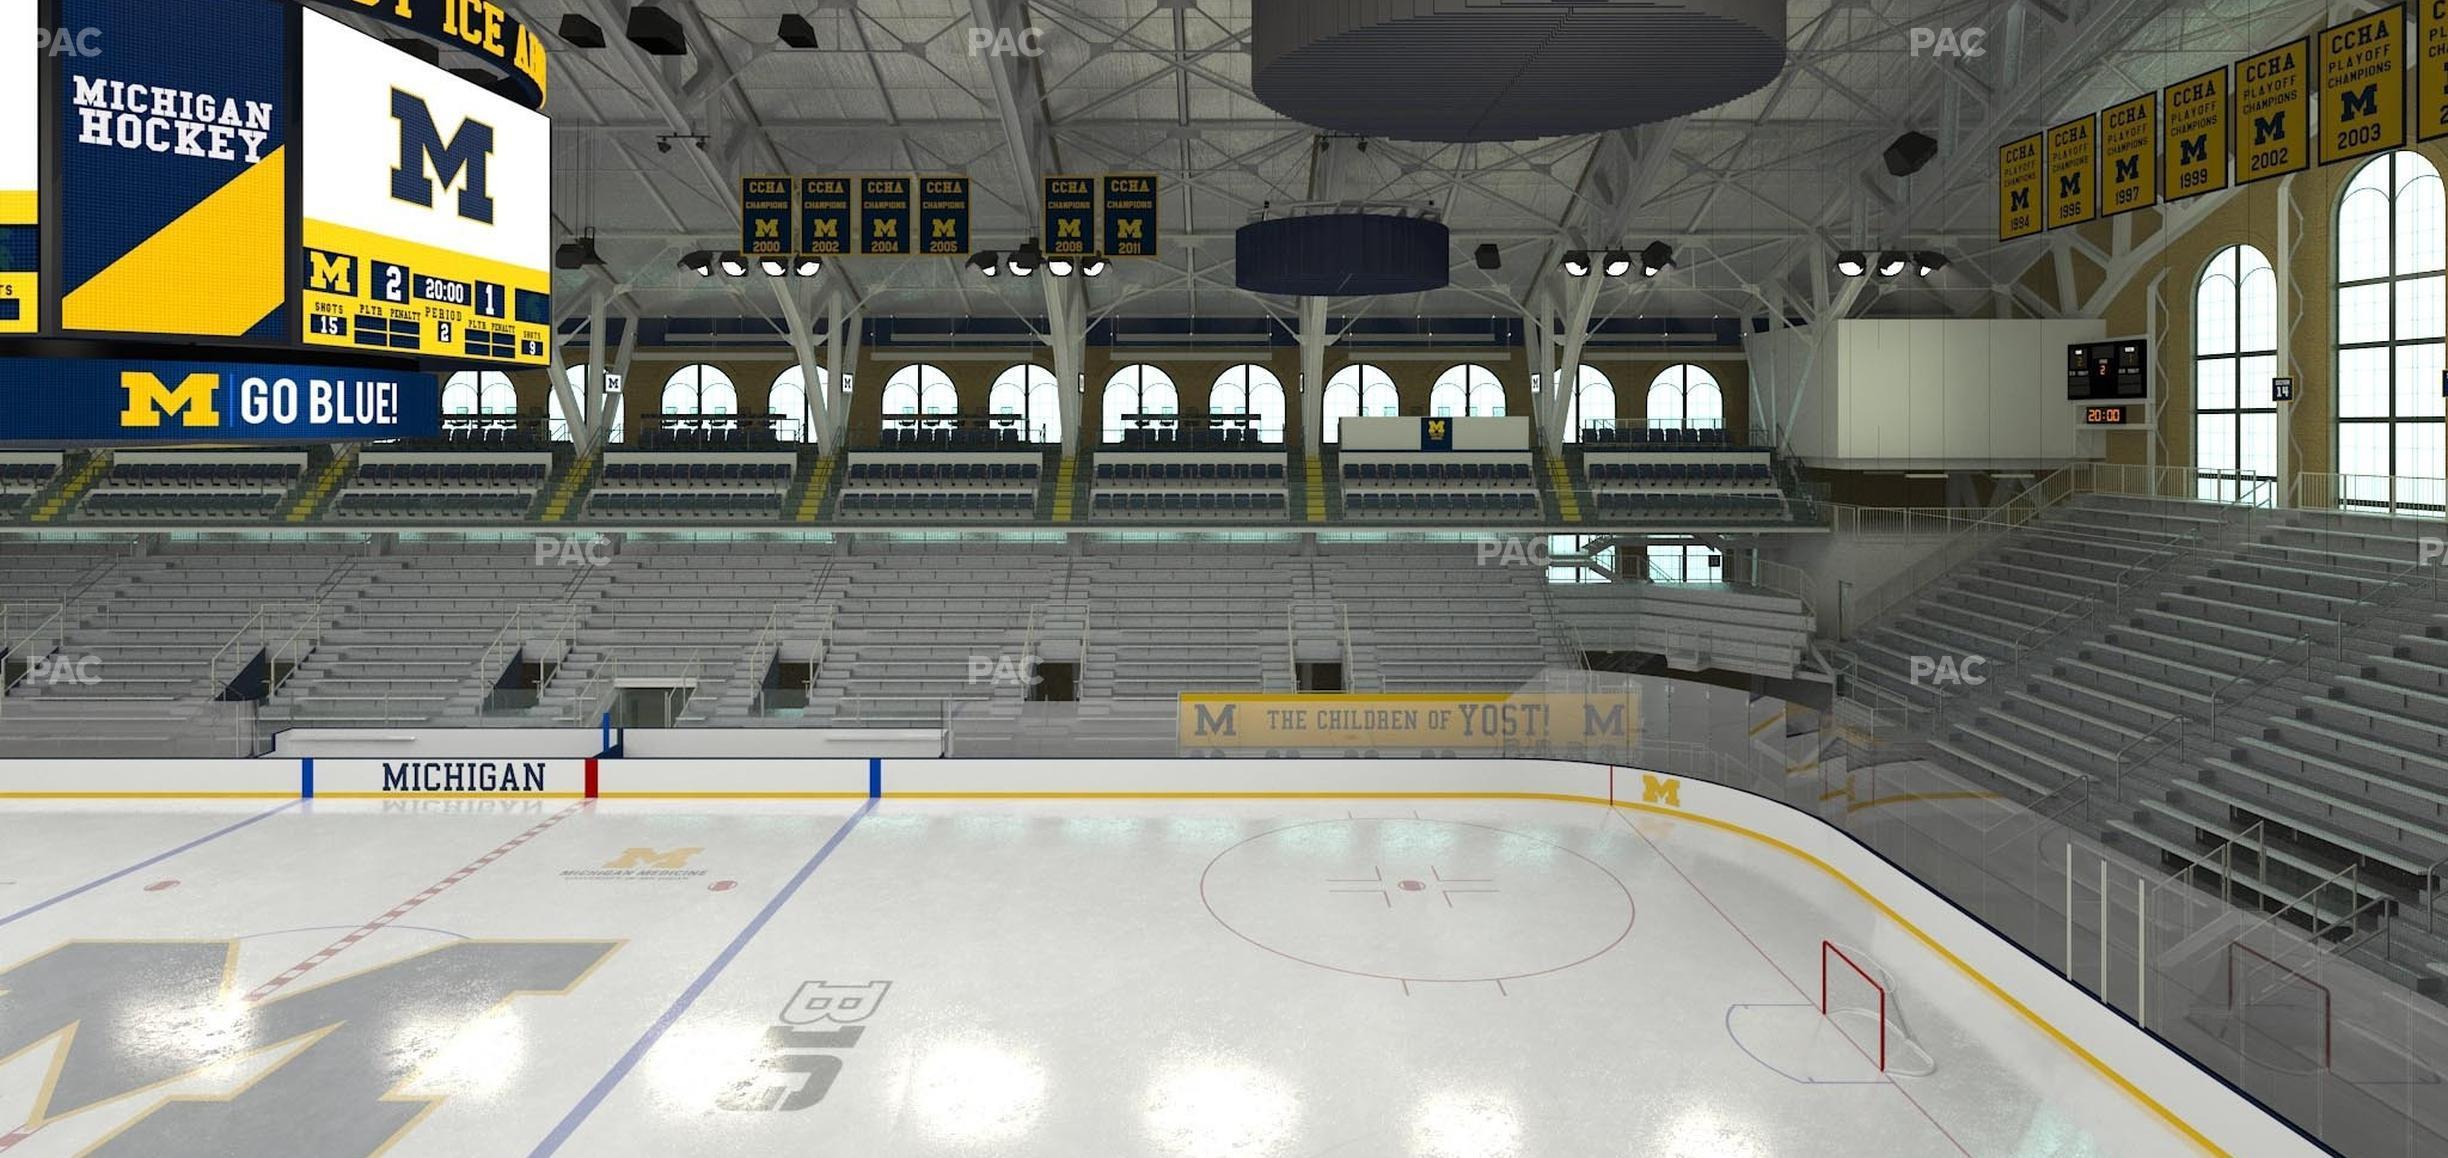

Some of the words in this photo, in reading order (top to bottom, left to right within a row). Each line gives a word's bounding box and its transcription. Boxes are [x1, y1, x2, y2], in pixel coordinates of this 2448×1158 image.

[443, 0, 505, 57] ICE
[2332, 20, 2389, 54] CCHA
[2246, 52, 2295, 83] CCHA
[2329, 44, 2391, 73] PLAYOFF
[2328, 60, 2392, 89] CHAMPIONS
[2173, 80, 2216, 107] CCHA
[2243, 75, 2296, 99] PLAYOFF
[73, 75, 273, 130] MICHIGAN
[2243, 90, 2297, 115] CHAMPIONS
[2341, 83, 2377, 122] M
[2110, 104, 2147, 128] CCHA
[2171, 101, 2216, 124] PLAYOFF
[79, 107, 267, 163] HOCKEY
[2108, 124, 2147, 144] PLAYOFF
[2171, 115, 2217, 137] CHAMPIONS
[2254, 111, 2285, 146] M
[2055, 125, 2087, 147] CCHA
[2338, 123, 2381, 150] 2003
[388, 83, 494, 225] M
[2006, 144, 2035, 163] CCHA
[2053, 143, 2088, 161] PLAYOFF
[2108, 138, 2148, 156] CHAMPIONS
[2180, 134, 2207, 166] M
[2115, 154, 2139, 183] M
[2252, 148, 2288, 171] 2002
[750, 182, 785, 193] CCHA
[808, 182, 843, 193] CCHA
[868, 182, 903, 193] CCHA
[927, 182, 962, 193] CCHA
[1052, 182, 1088, 193] CCHA
[1111, 180, 1150, 192] CCHA
[2060, 172, 2080, 198] M
[2180, 168, 2207, 189] 1999
[2010, 187, 2029, 212] M
[2116, 186, 2139, 205] 1997
[2060, 202, 2081, 219] 1996
[755, 219, 779, 237] M
[813, 219, 837, 237] M
[873, 219, 897, 237] M
[932, 219, 956, 237] M
[1058, 219, 1081, 237] M
[1117, 219, 1143, 238] M
[753, 241, 780, 252] 2000
[811, 241, 838, 252] 2002
[871, 241, 898, 252] 2004
[930, 241, 957, 252] 2005
[1118, 242, 1141, 254] 2011
[310, 250, 351, 293] M
[386, 266, 401, 301] 2
[425, 278, 464, 303] 20:00
[315, 302, 344, 315] SHOTS
[485, 284, 495, 315] 1
[359, 304, 383, 316] PLYR
[390, 308, 420, 321] PENALTY
[425, 306, 462, 321] PERIOD
[321, 315, 338, 334] 15
[440, 324, 449, 341] 2
[491, 323, 515, 333] PENALTY
[523, 331, 541, 339] SHOTS
[529, 341, 536, 355] 9
[2100, 365, 2105, 375] 2
[608, 378, 618, 388] M
[2277, 386, 2289, 397] 14
[121, 371, 219, 427] M
[241, 377, 298, 424] GO
[309, 379, 398, 424] BLUE!
[2088, 409, 2119, 421] 20:00
[1428, 420, 1445, 433] M
[1194, 703, 1237, 736] M
[1267, 710, 1307, 730] THE
[1317, 710, 1418, 730] CHILDREN
[1428, 710, 1452, 730] OF
[1458, 703, 1550, 737] YOST!
[1583, 704, 1625, 736] M
[383, 762, 546, 791] MICHIGAN
[1642, 773, 1680, 807] M
